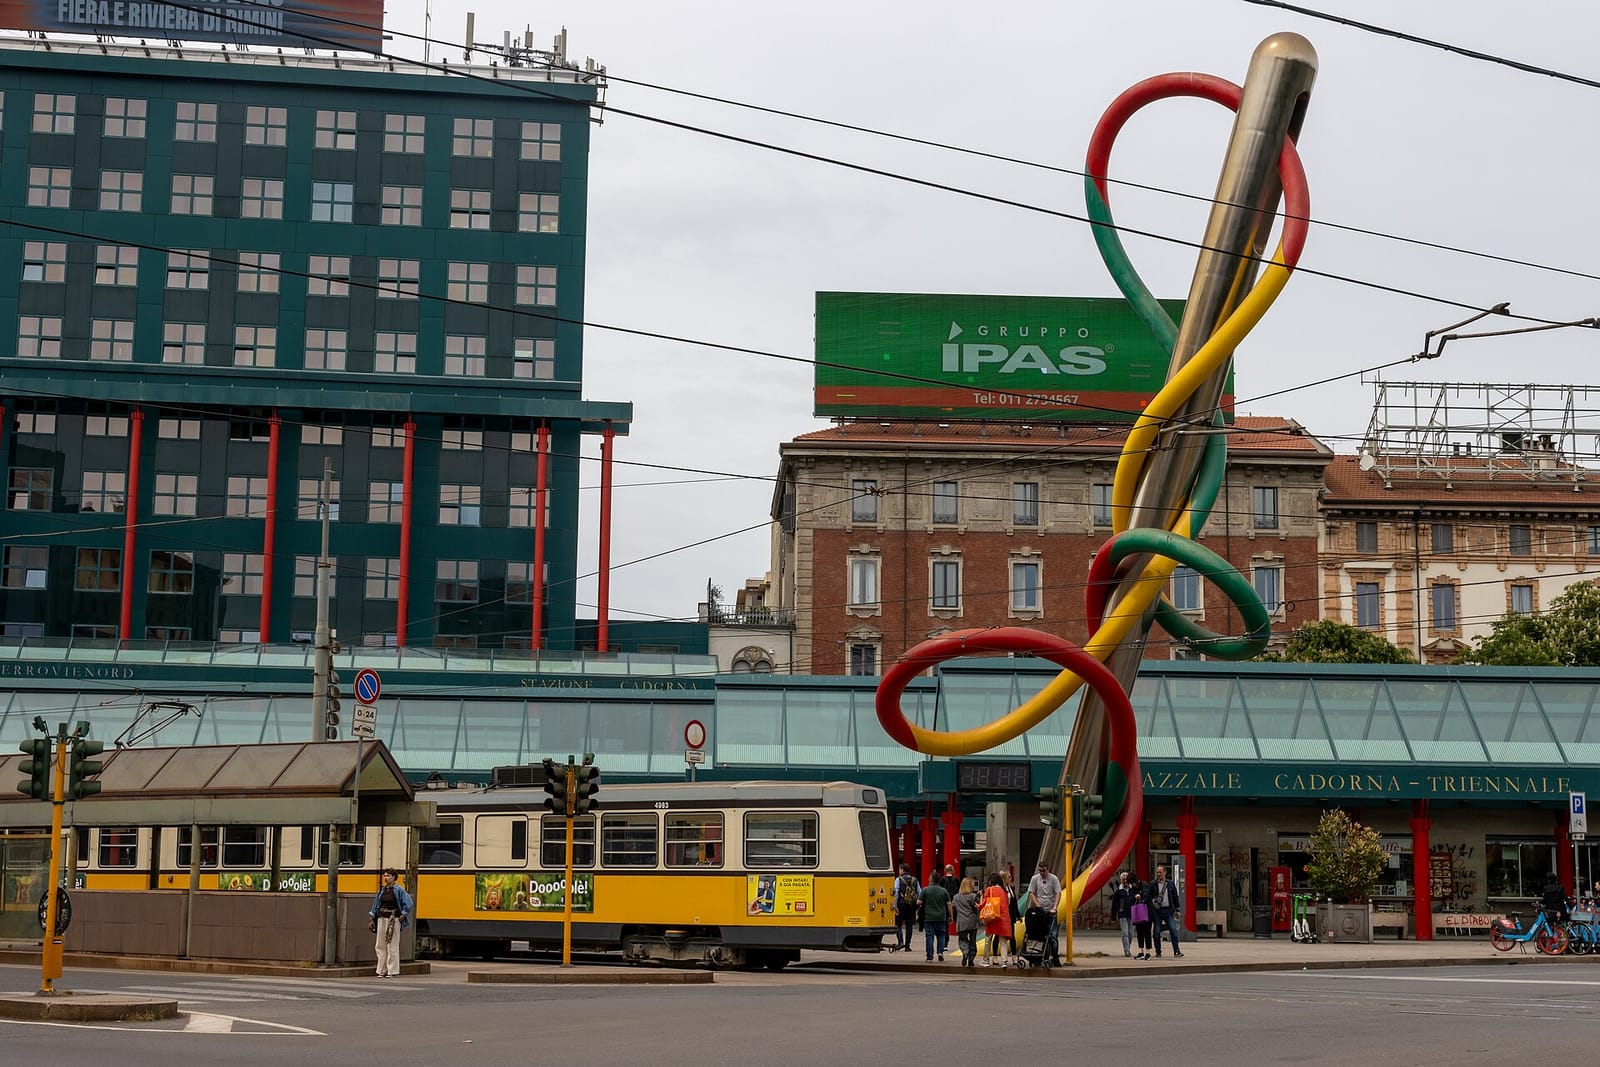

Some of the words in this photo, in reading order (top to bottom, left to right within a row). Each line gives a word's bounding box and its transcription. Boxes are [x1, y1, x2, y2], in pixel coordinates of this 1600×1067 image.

[57, 1, 110, 25] FIERA
[113, 6, 125, 26] E
[128, 6, 199, 31] RIVIERA
[202, 8, 222, 32] DI
[225, 9, 284, 36] RIMINI
[978, 325, 1089, 338] GRUPPO
[973, 393, 996, 404] Tel:
[999, 393, 1021, 405] 011
[1025, 394, 1079, 405] 2734567
[1, 664, 134, 678] ERROVIENORD
[520, 678, 593, 689] STAZIONE
[620, 680, 698, 691] CADORNA
[1142, 772, 1242, 789] AZZALE
[1274, 774, 1401, 791] CADORNA
[1427, 776, 1571, 793] TRIENNALE
[1574, 797, 1581, 812] P
